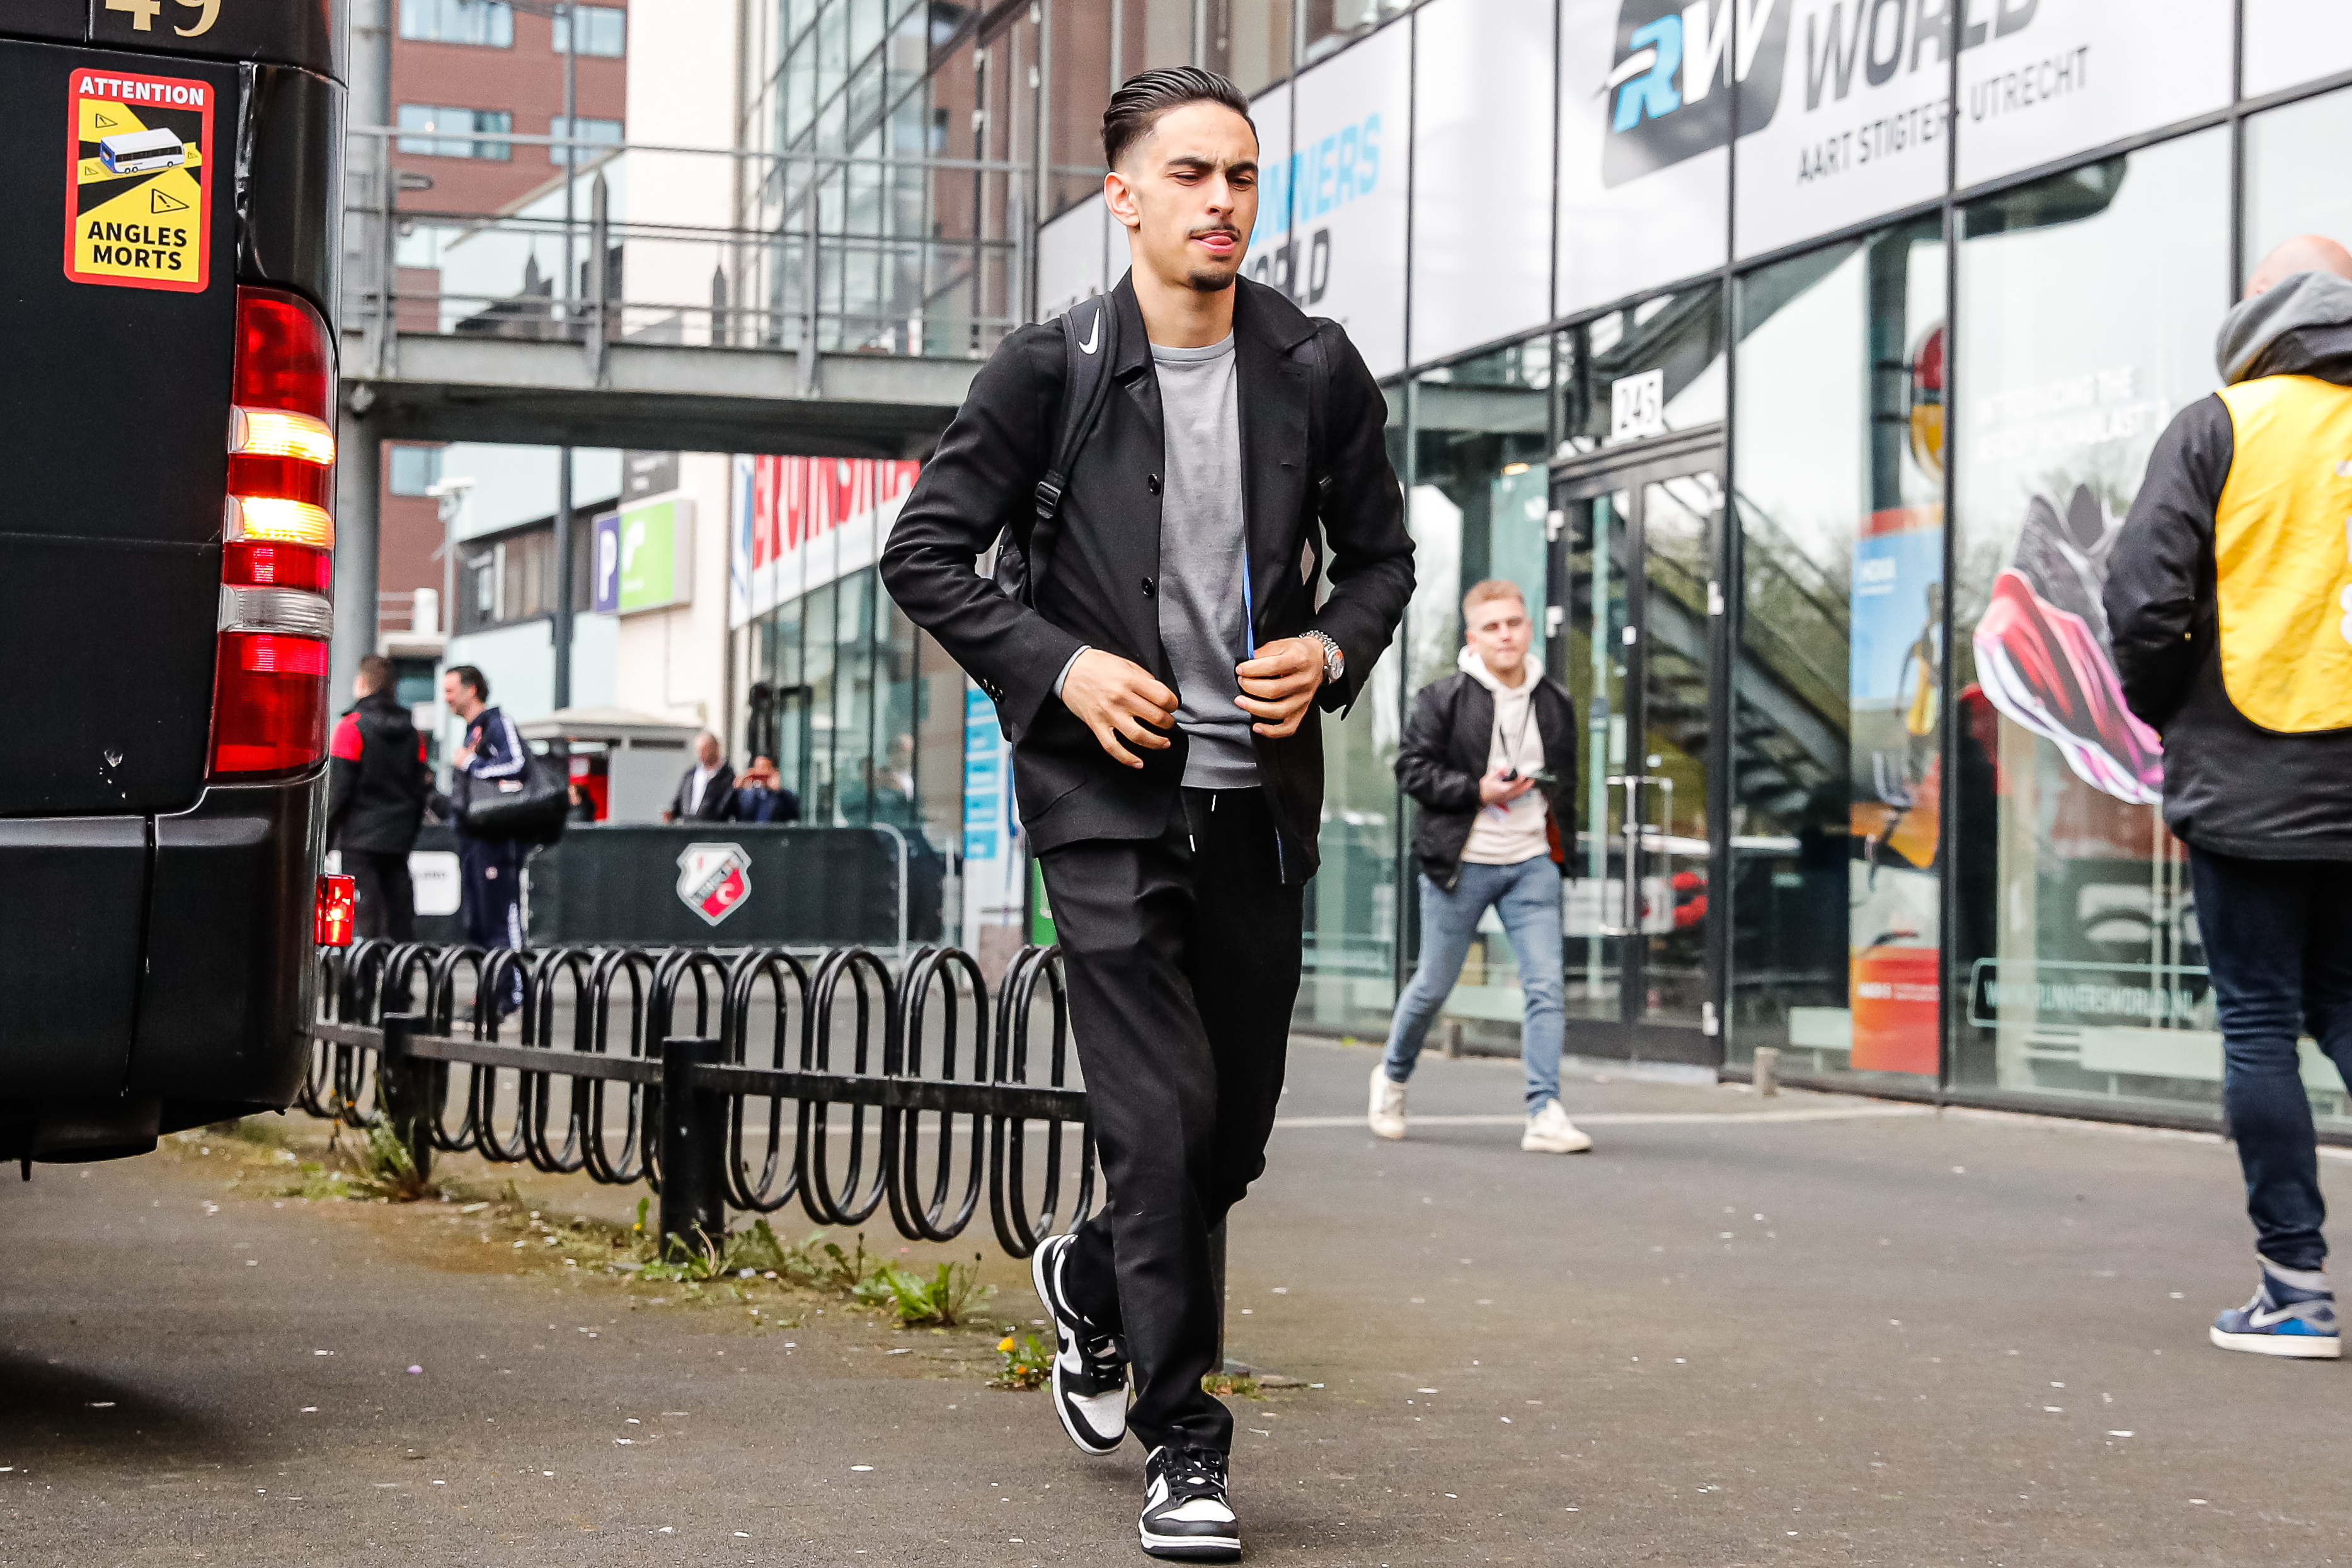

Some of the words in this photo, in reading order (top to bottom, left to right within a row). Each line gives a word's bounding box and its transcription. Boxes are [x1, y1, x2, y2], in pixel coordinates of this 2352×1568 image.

[78, 76, 205, 106] ATTENTION
[1798, 130, 1852, 185] AART
[1970, 44, 2091, 123] UTRECHT
[87, 220, 188, 248] ANGLES
[93, 244, 182, 271] MORTS
